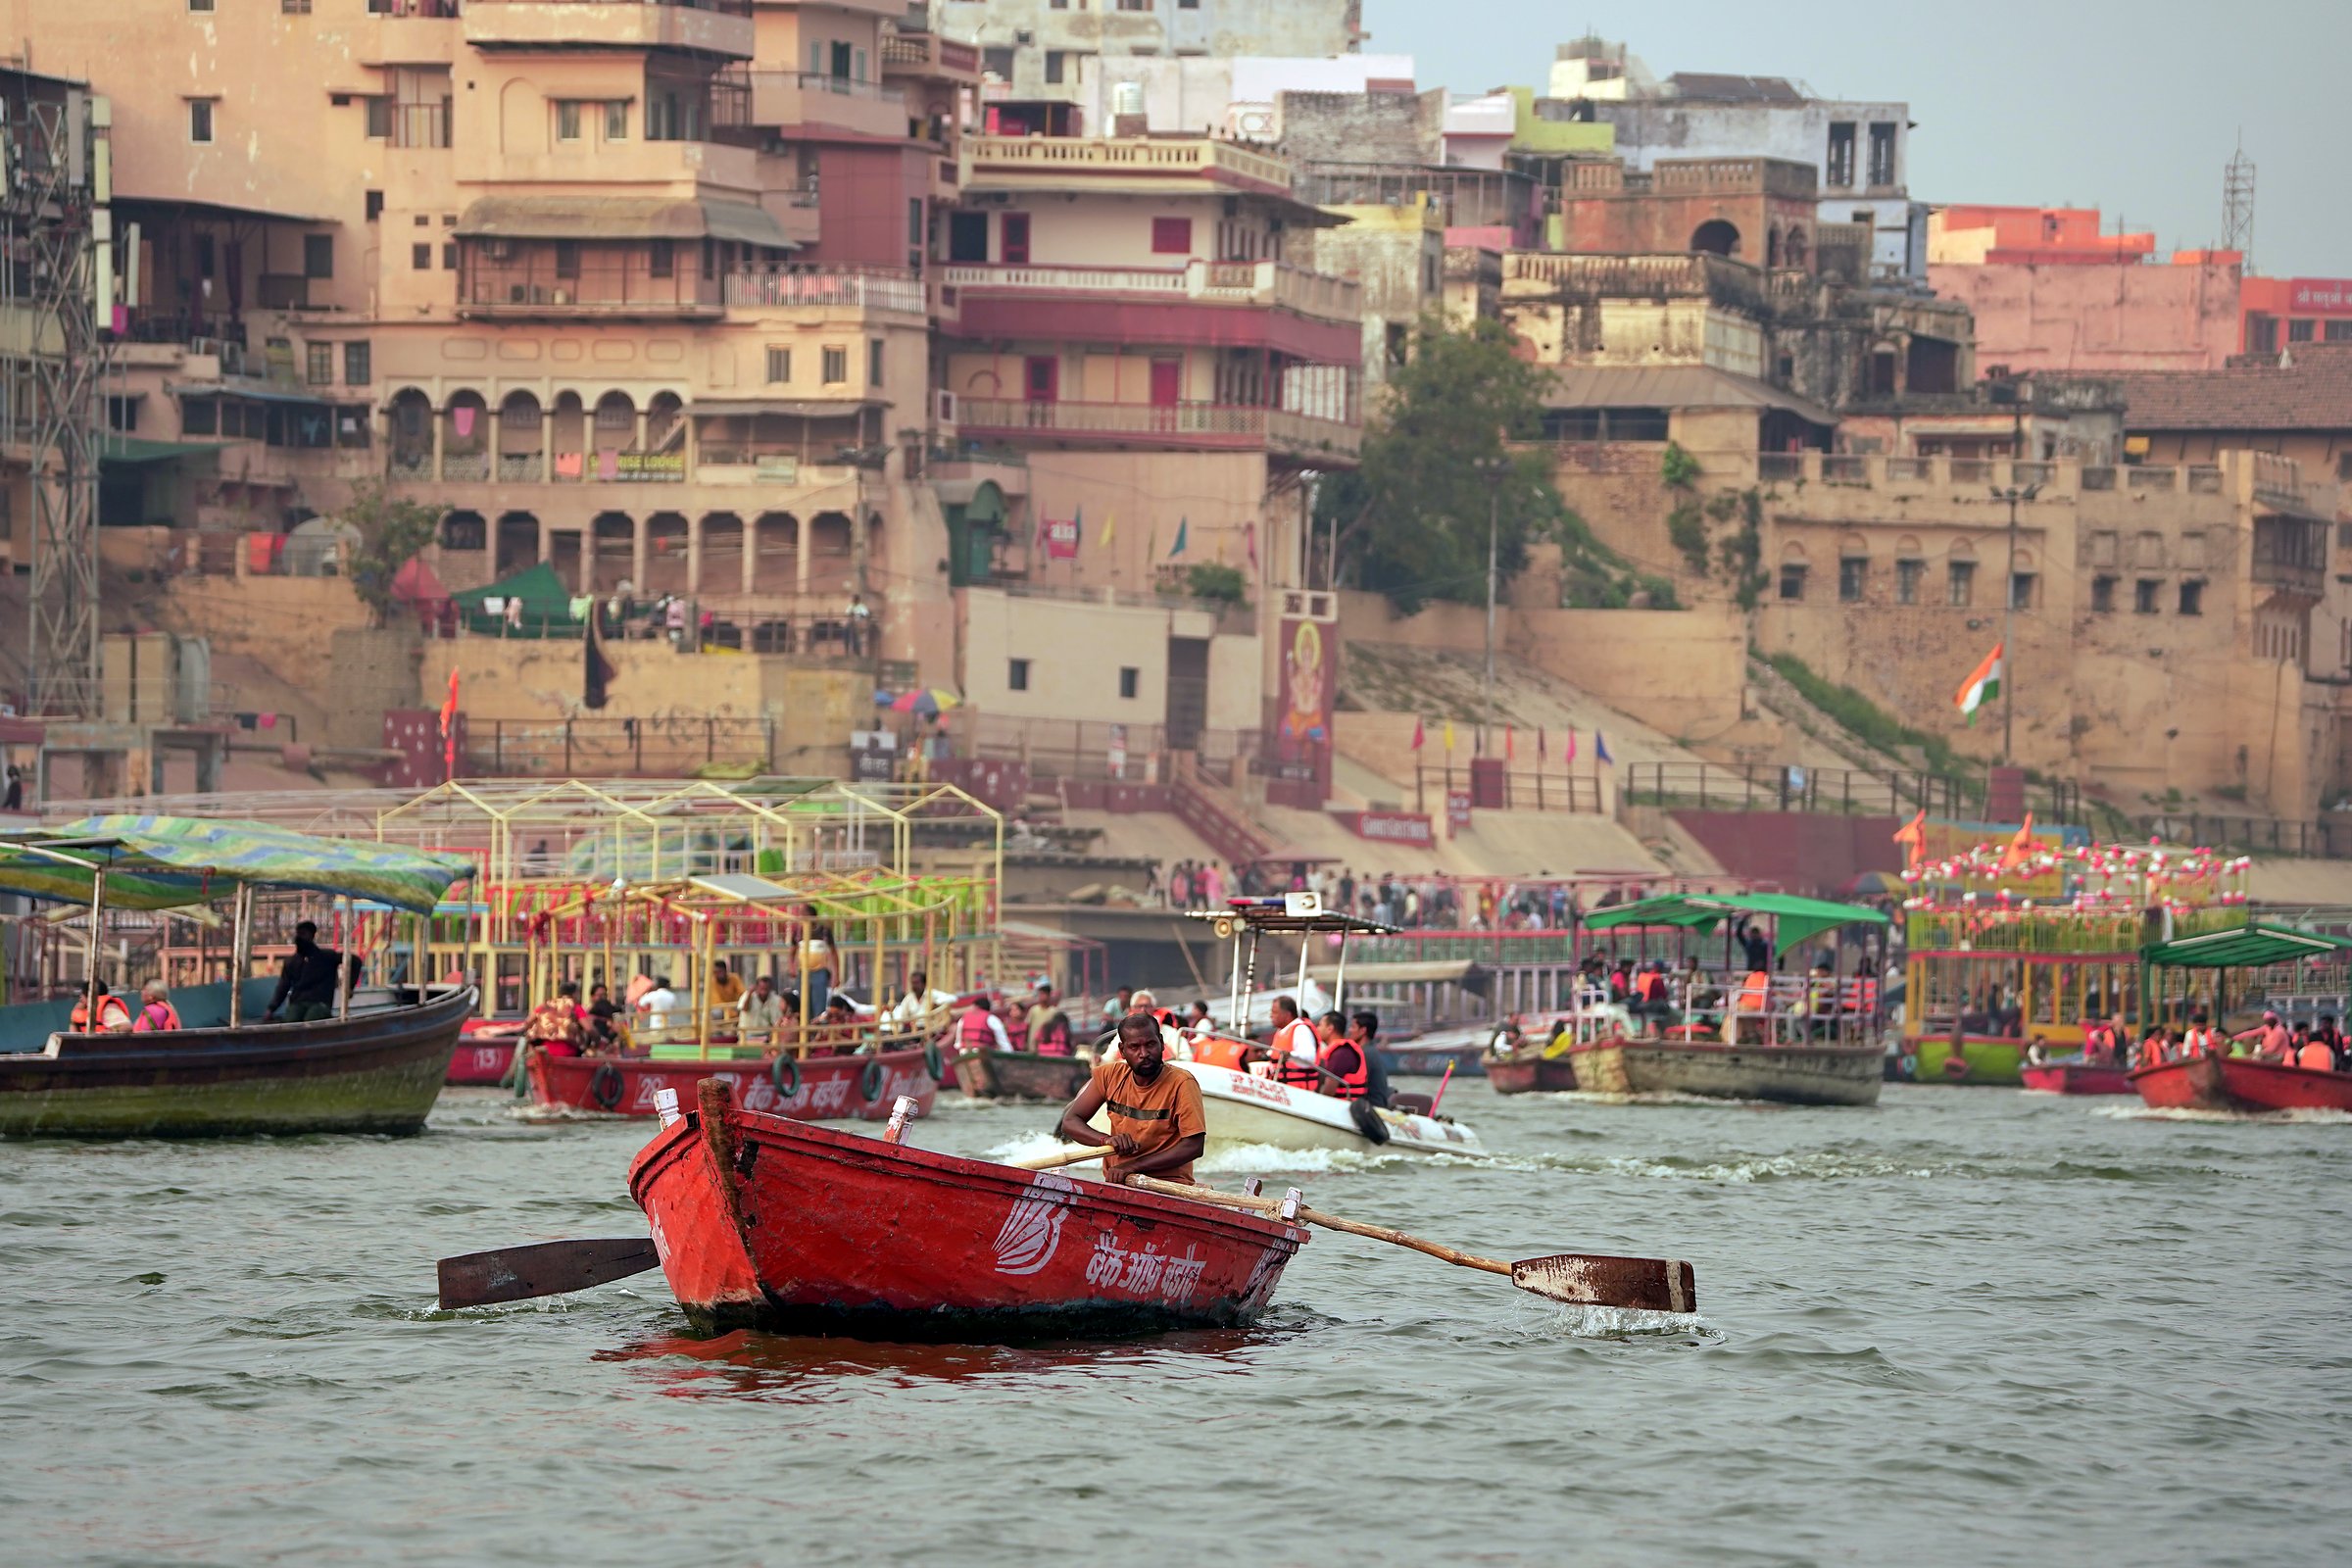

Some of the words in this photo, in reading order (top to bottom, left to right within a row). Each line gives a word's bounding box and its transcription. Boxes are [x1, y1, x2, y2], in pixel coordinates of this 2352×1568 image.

[589, 454, 643, 469] SRISE
[645, 454, 683, 470] LODGE
[1085, 1232, 1128, 1289] बैंक
